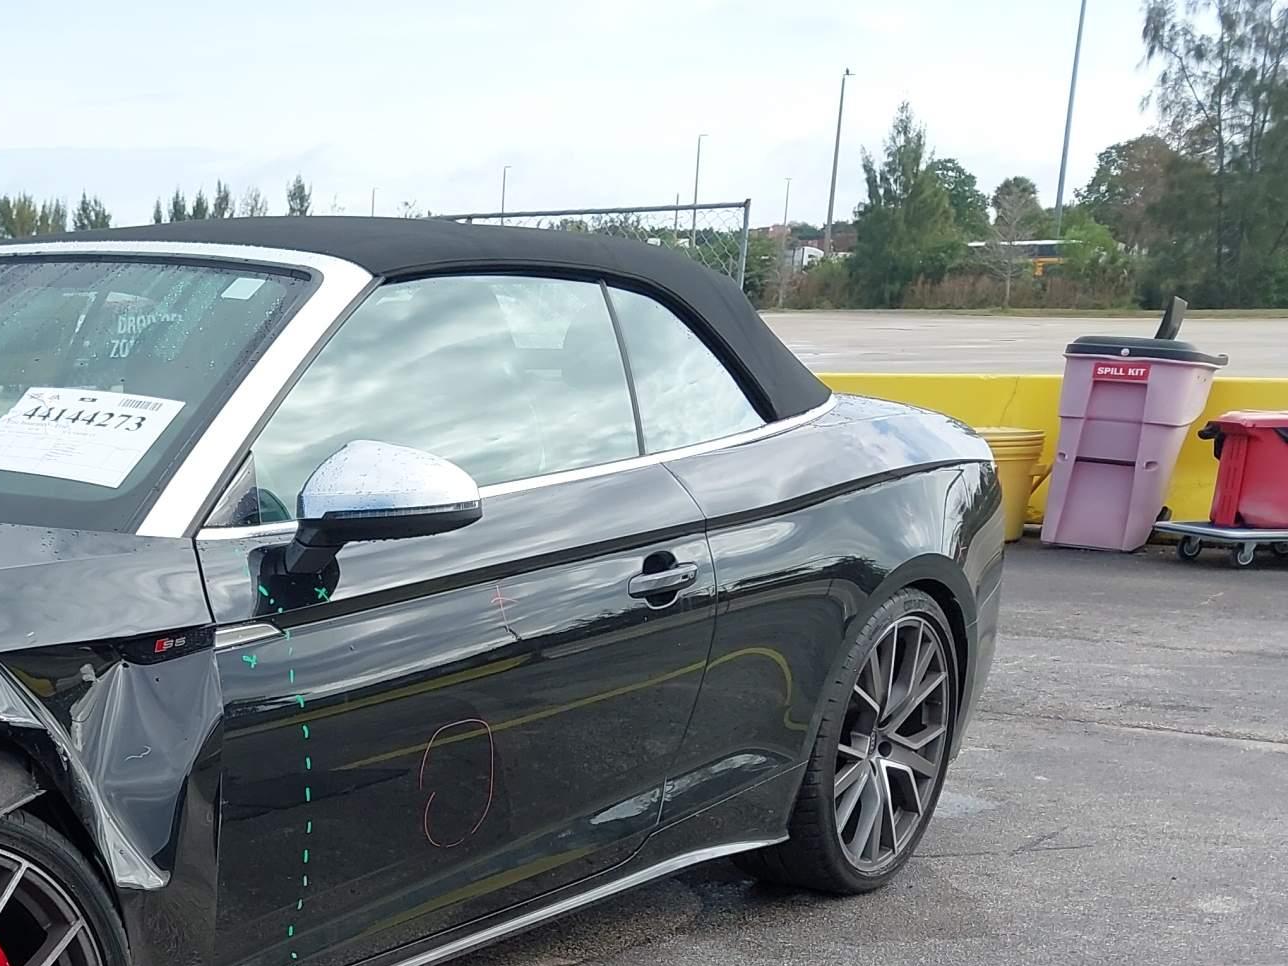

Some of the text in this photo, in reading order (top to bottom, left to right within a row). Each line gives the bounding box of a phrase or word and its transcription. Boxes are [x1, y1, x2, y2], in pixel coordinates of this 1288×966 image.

[1096, 366, 1147, 376] SPILL KIT
[23, 405, 147, 432] 44144273
[161, 636, 186, 650] S5
